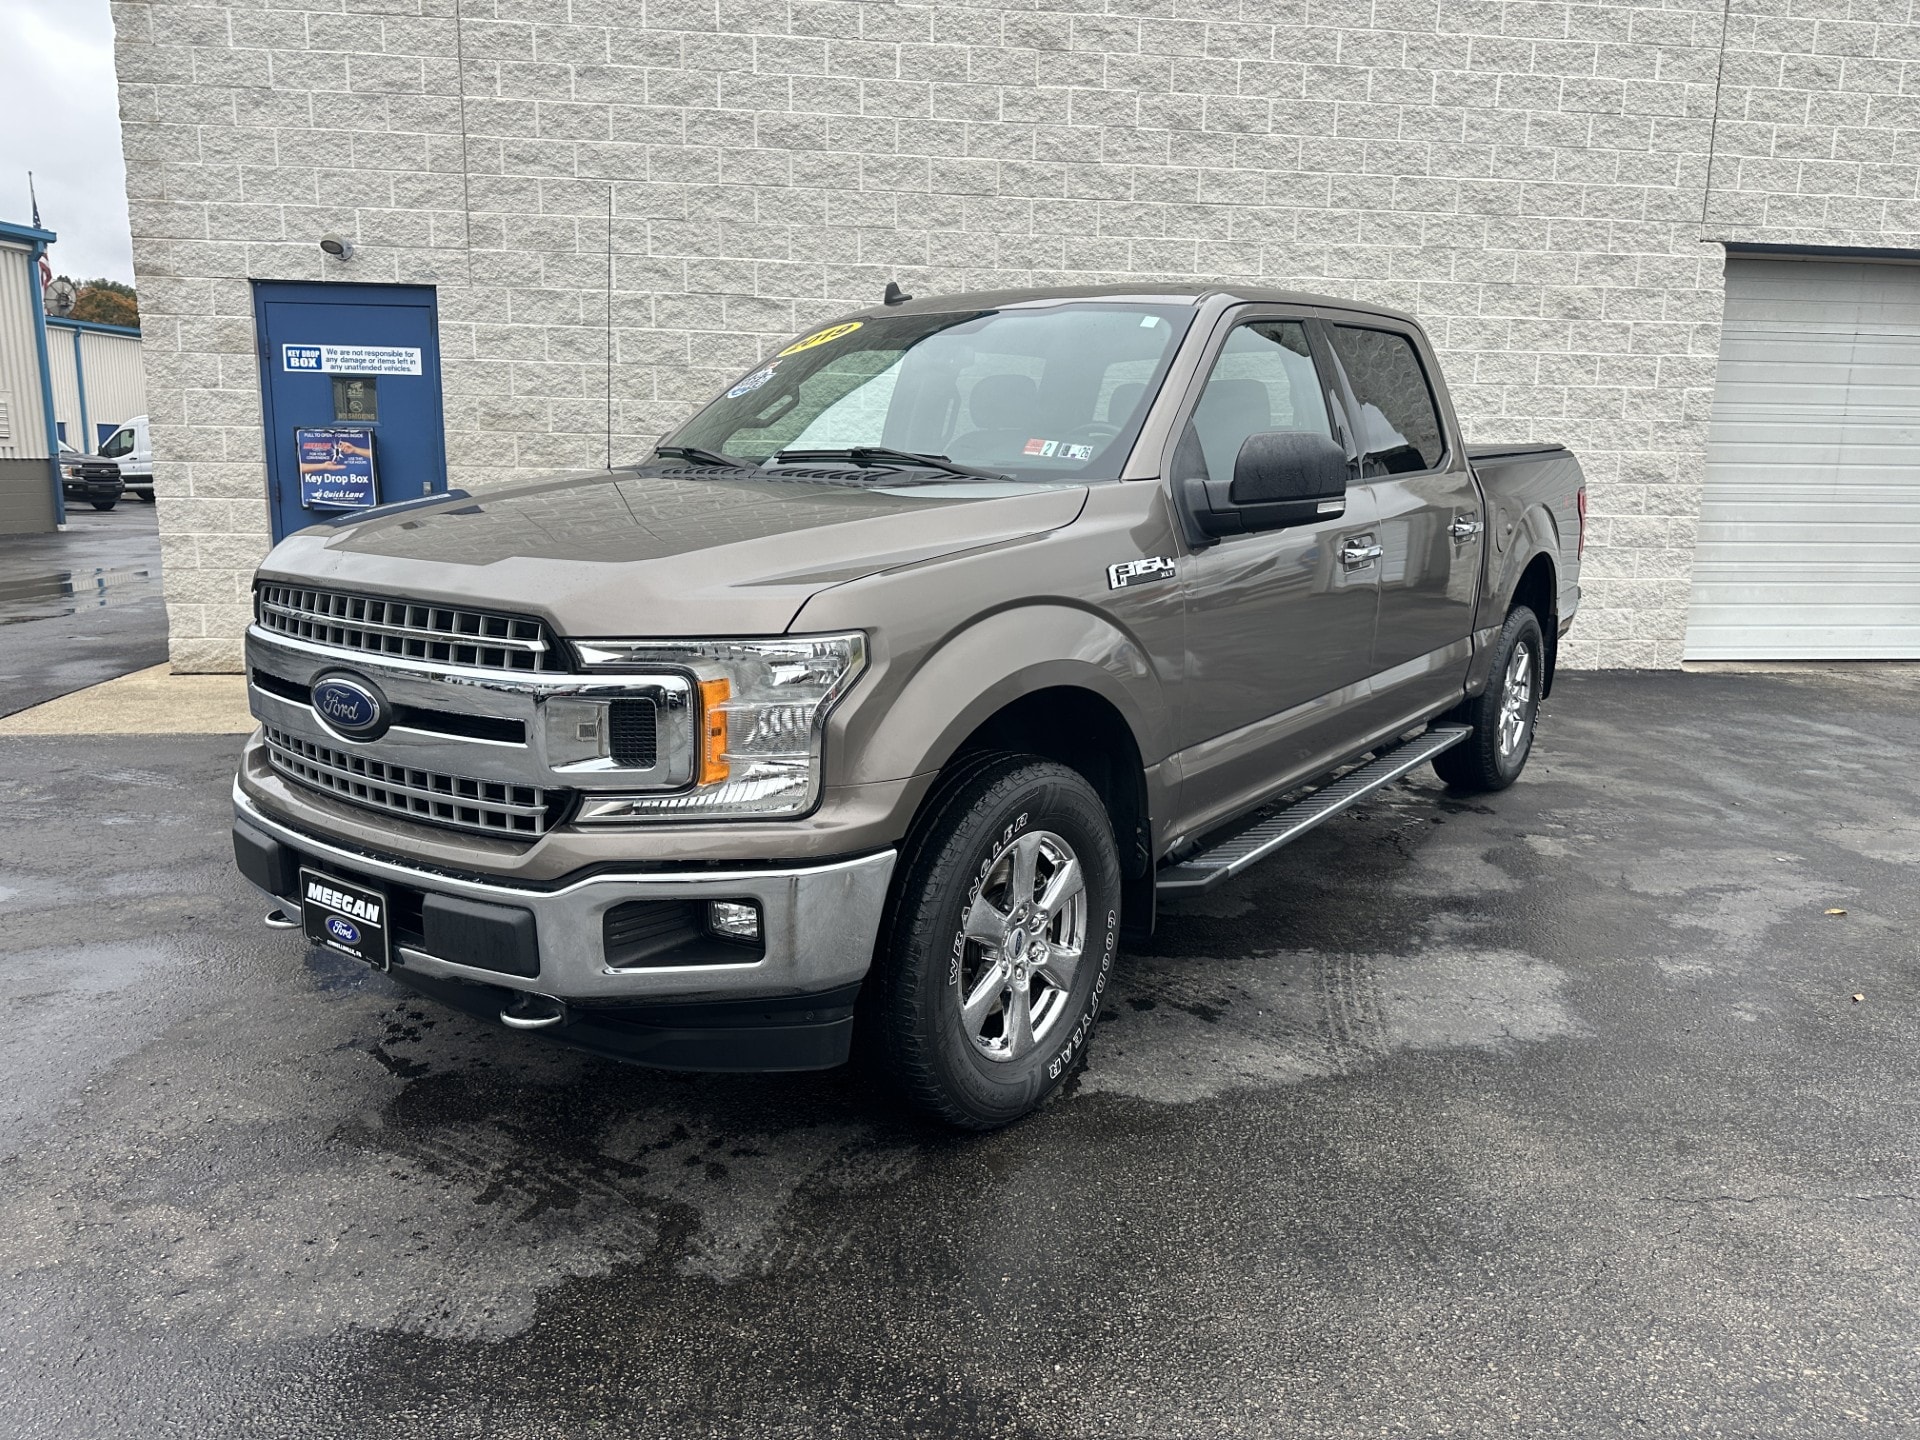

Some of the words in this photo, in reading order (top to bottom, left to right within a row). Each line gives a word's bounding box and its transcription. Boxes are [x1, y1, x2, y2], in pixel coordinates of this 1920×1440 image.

[287, 349, 300, 357] KEY
[301, 349, 320, 357] DROP
[364, 350, 403, 360] responsible
[290, 358, 318, 368] BOX
[340, 356, 367, 366] damage
[1043, 442, 1052, 455] 2
[304, 473, 322, 485] Key
[324, 473, 348, 485] Drop
[350, 474, 368, 483] Box
[1160, 570, 1174, 578] XLT
[323, 688, 359, 720] Ford
[307, 882, 380, 922] MEEGAN
[332, 920, 352, 939] Ford
[1048, 909, 1117, 1080] GOODYEAR
